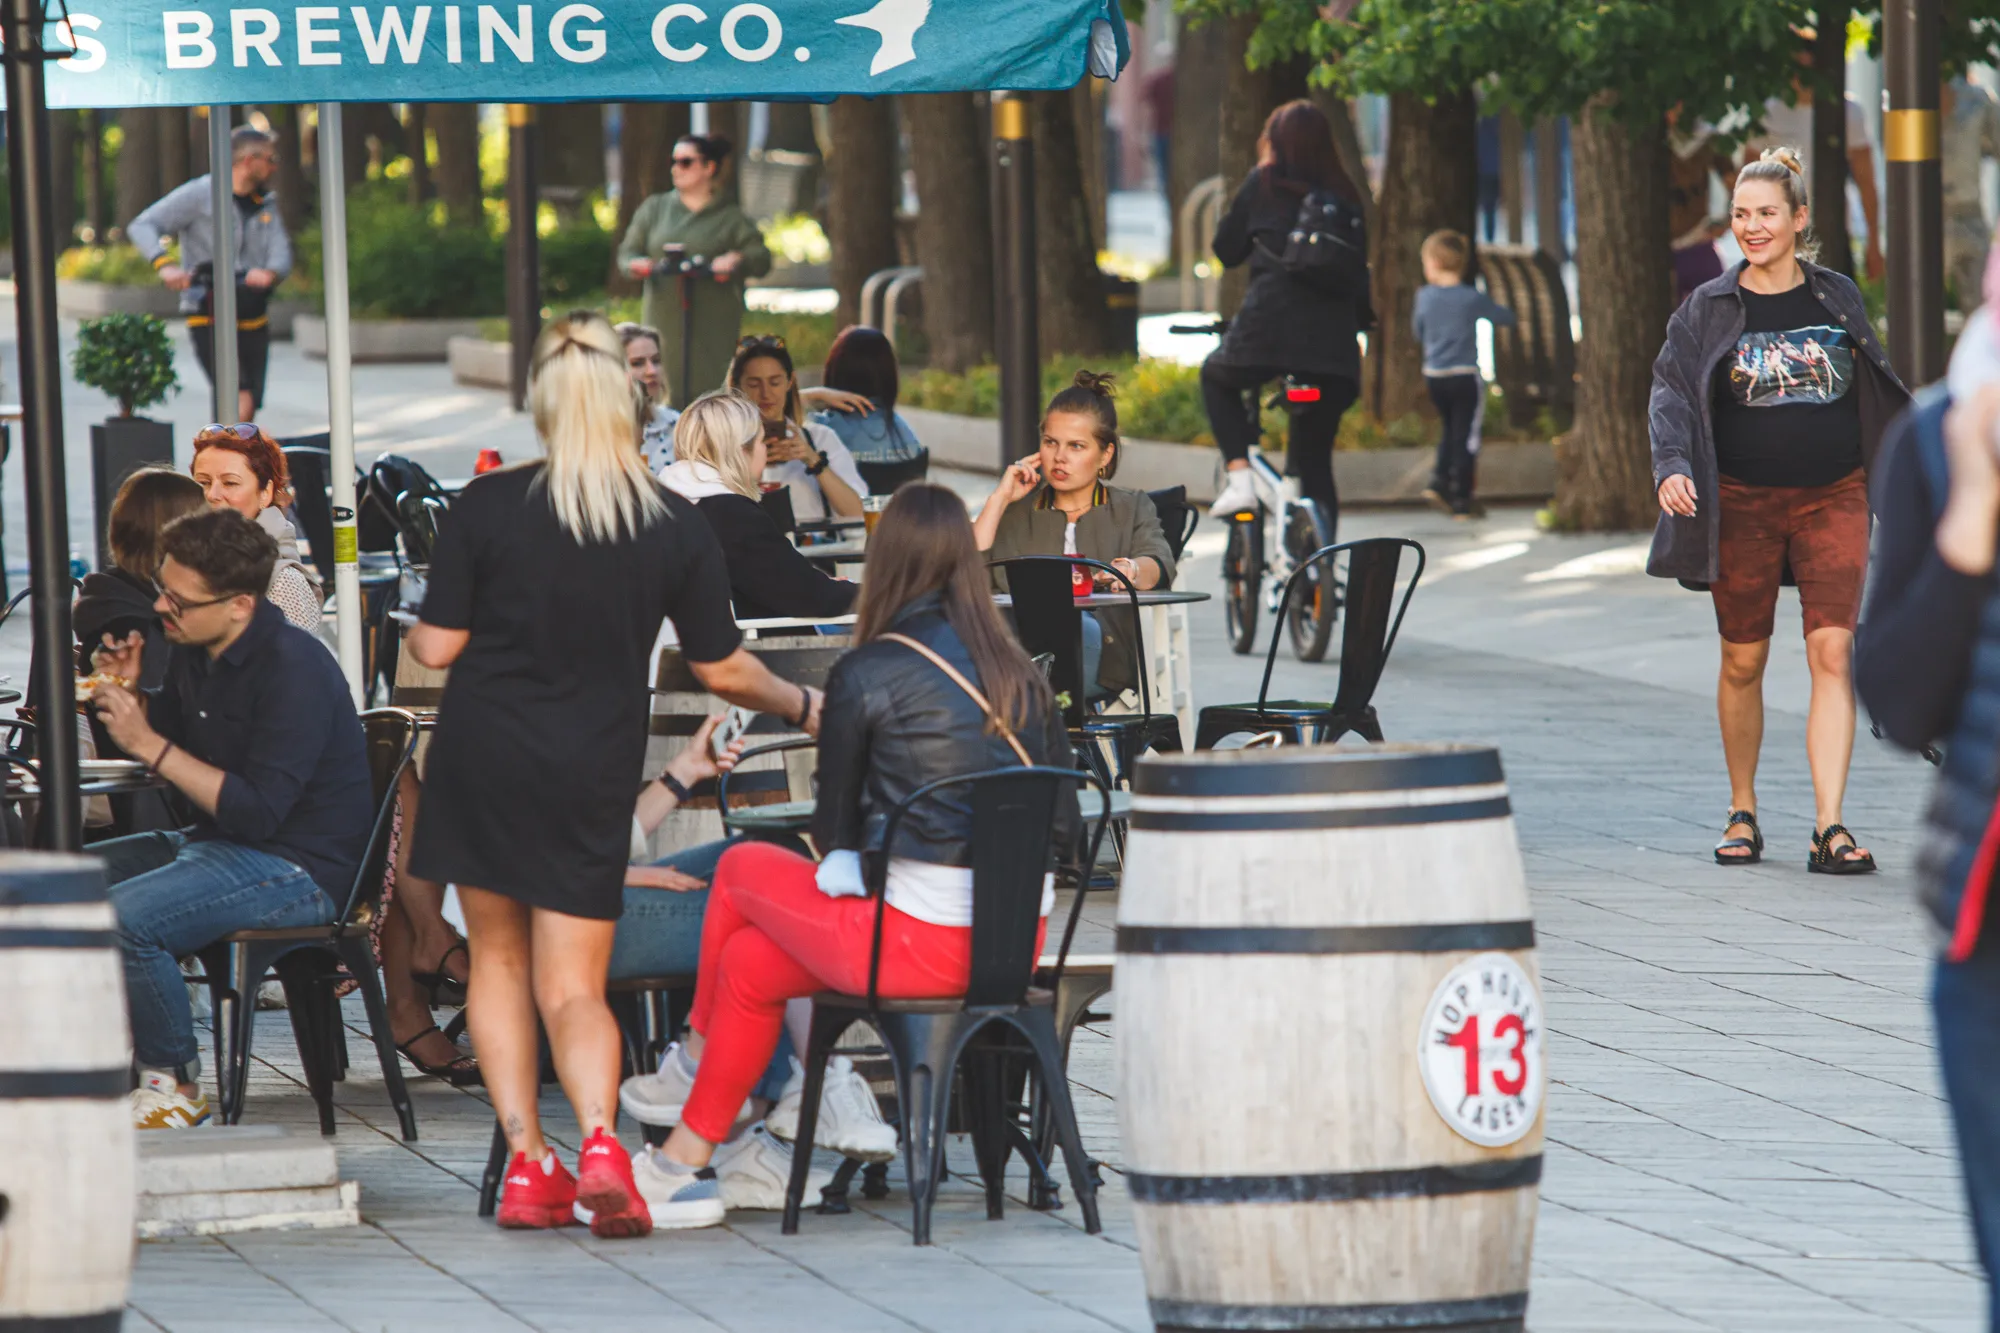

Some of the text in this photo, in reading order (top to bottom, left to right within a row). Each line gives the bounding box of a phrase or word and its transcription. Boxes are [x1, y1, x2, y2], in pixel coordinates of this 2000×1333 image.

[163, 4, 607, 69] BREWING
[651, 3, 811, 62] CO.
[1434, 984, 1468, 1046] HOP
[1449, 1013, 1528, 1096] 13
[1456, 1090, 1527, 1131] LAGER
